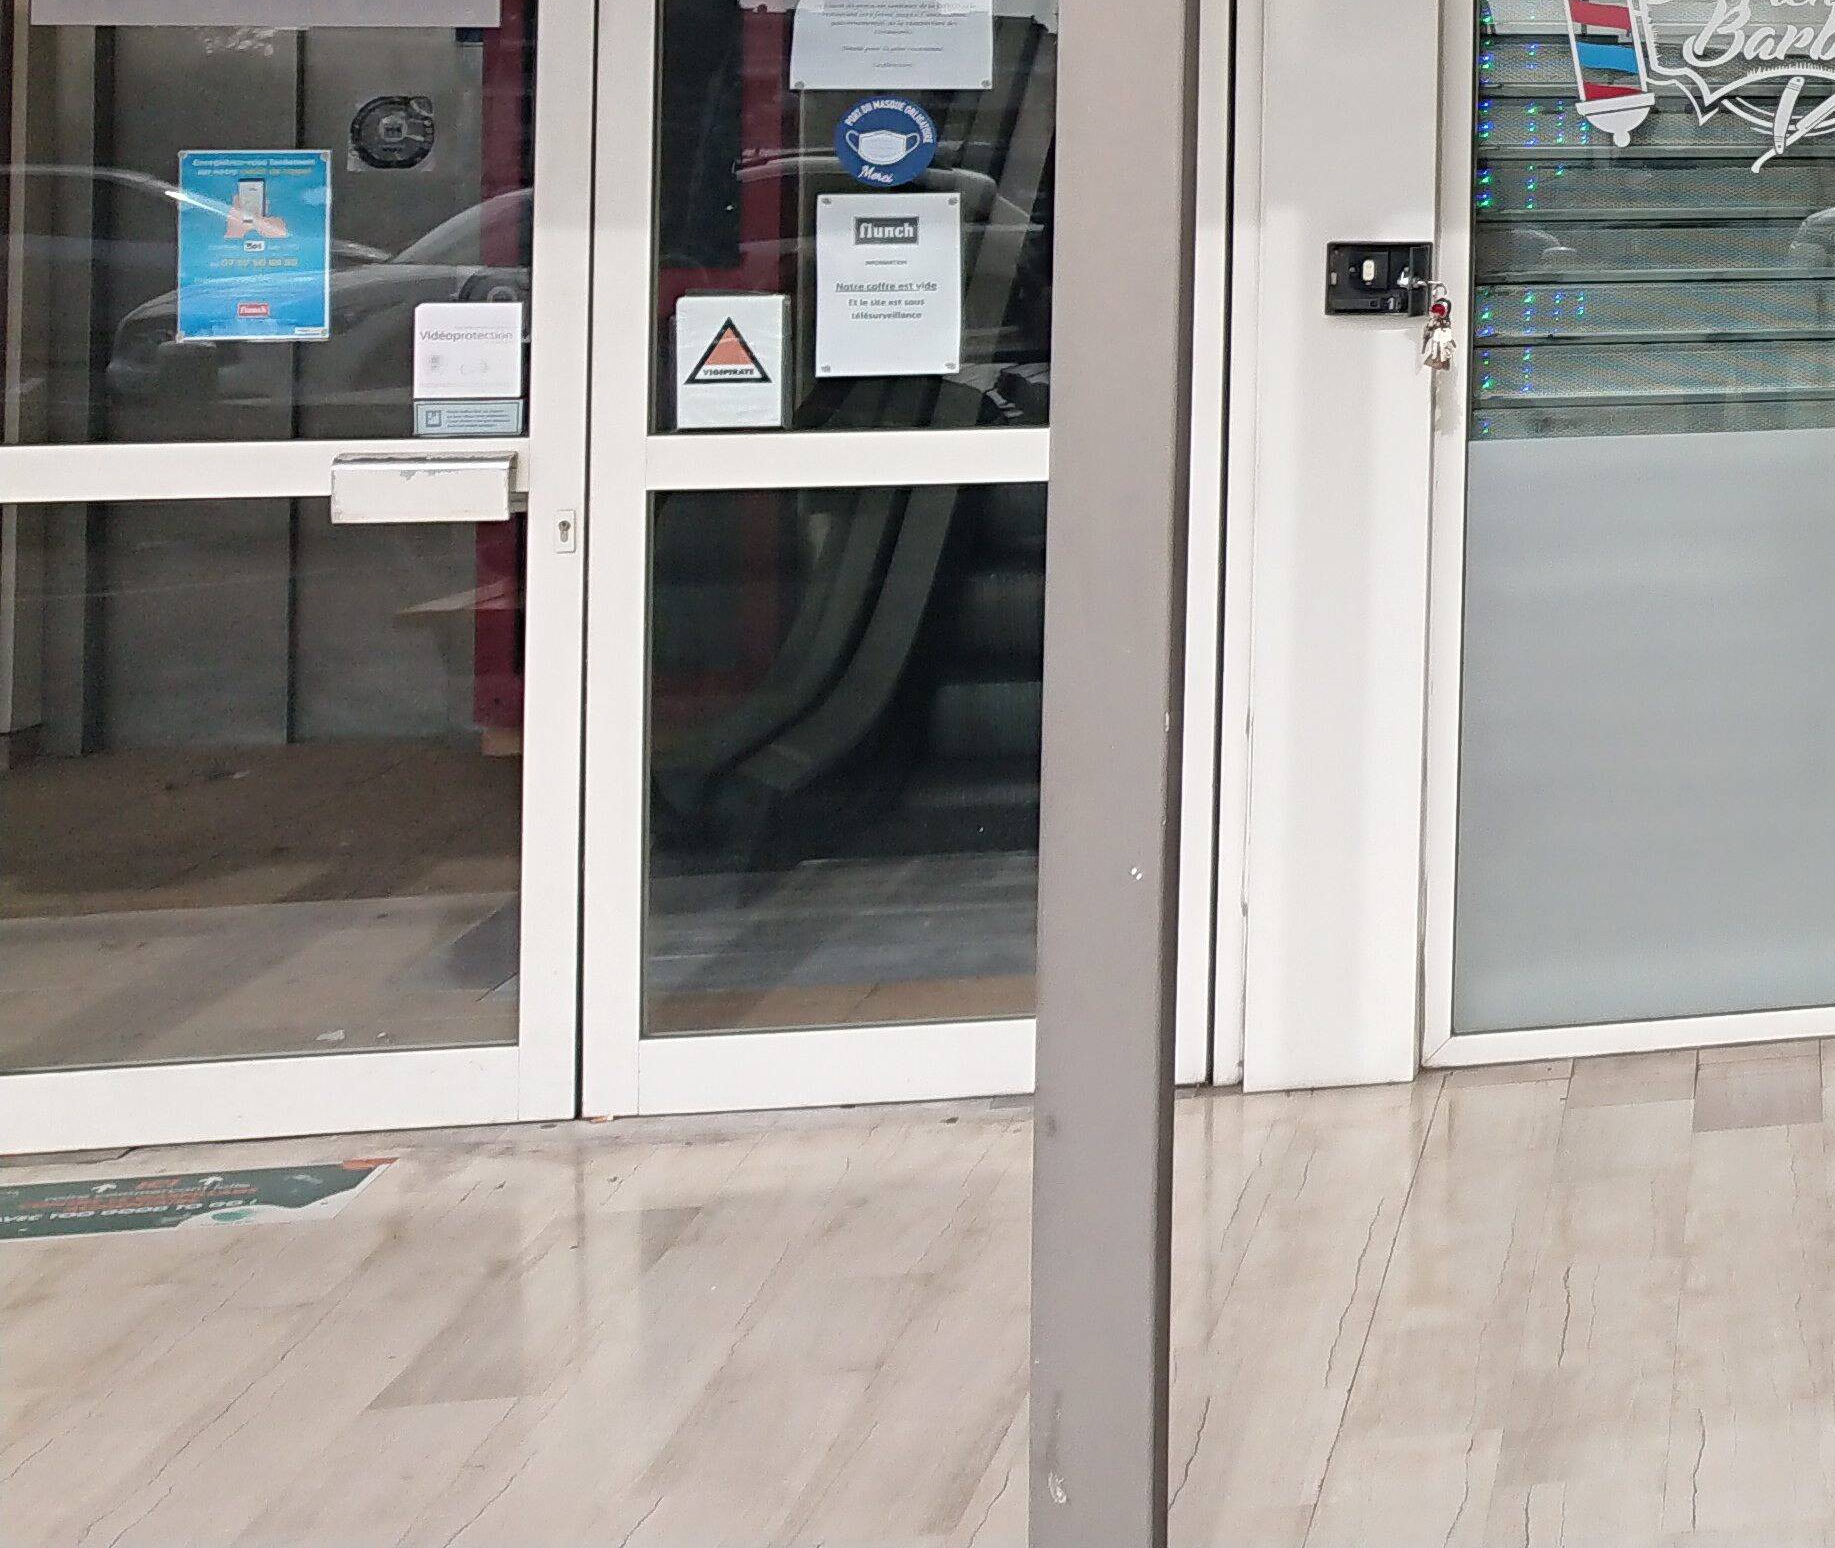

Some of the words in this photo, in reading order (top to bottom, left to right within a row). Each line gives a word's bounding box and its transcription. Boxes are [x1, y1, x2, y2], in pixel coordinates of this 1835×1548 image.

[873, 100, 905, 111] MASQUE
[858, 165, 894, 183] Merci
[859, 223, 915, 239] flunch
[836, 282, 863, 292] Notre
[867, 282, 895, 292] coffre
[898, 283, 912, 291] est
[916, 282, 937, 291] vide
[419, 330, 513, 343] Vidéoprotection
